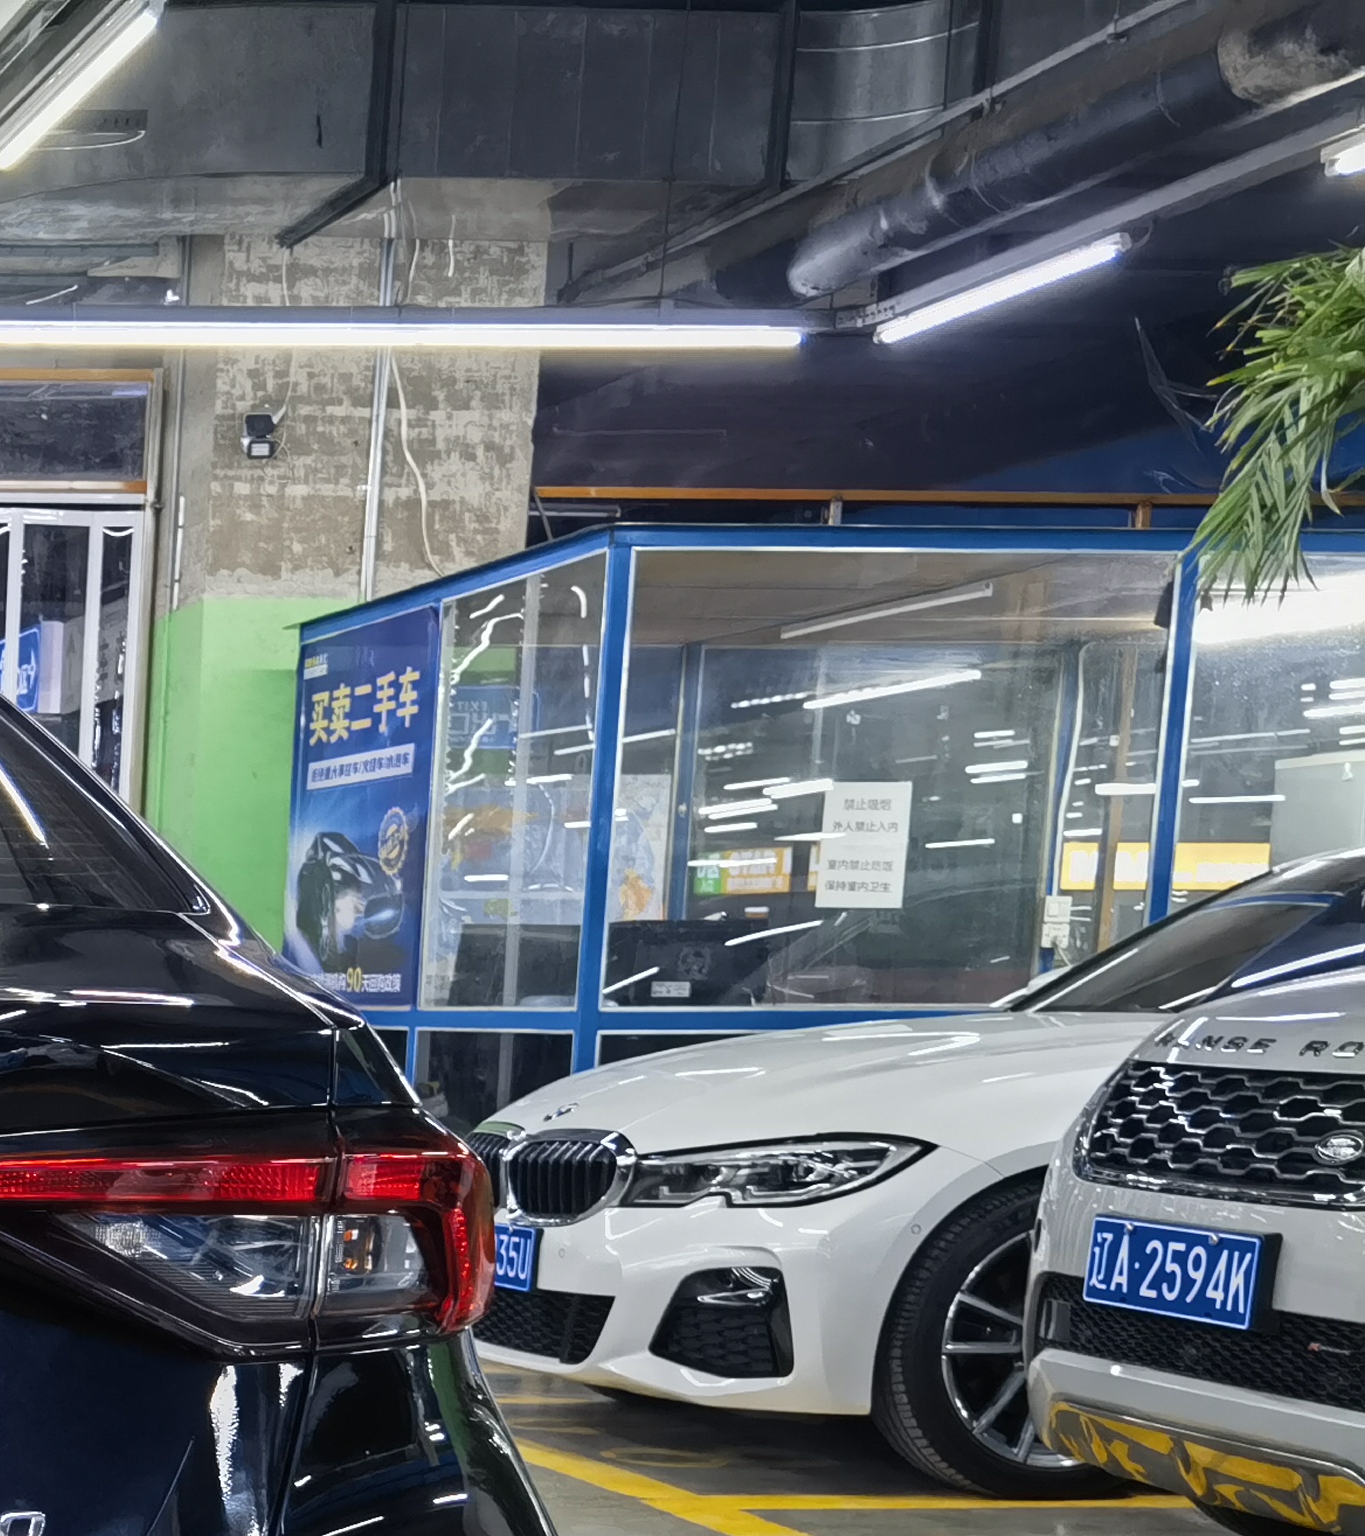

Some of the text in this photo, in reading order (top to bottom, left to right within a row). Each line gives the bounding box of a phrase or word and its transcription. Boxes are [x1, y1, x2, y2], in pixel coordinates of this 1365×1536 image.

[309, 666, 421, 746] 买卖二手车
[832, 821, 899, 833] 外人禁止入内
[824, 881, 893, 893] 保持室内卫生
[495, 1233, 531, 1280] 35U
